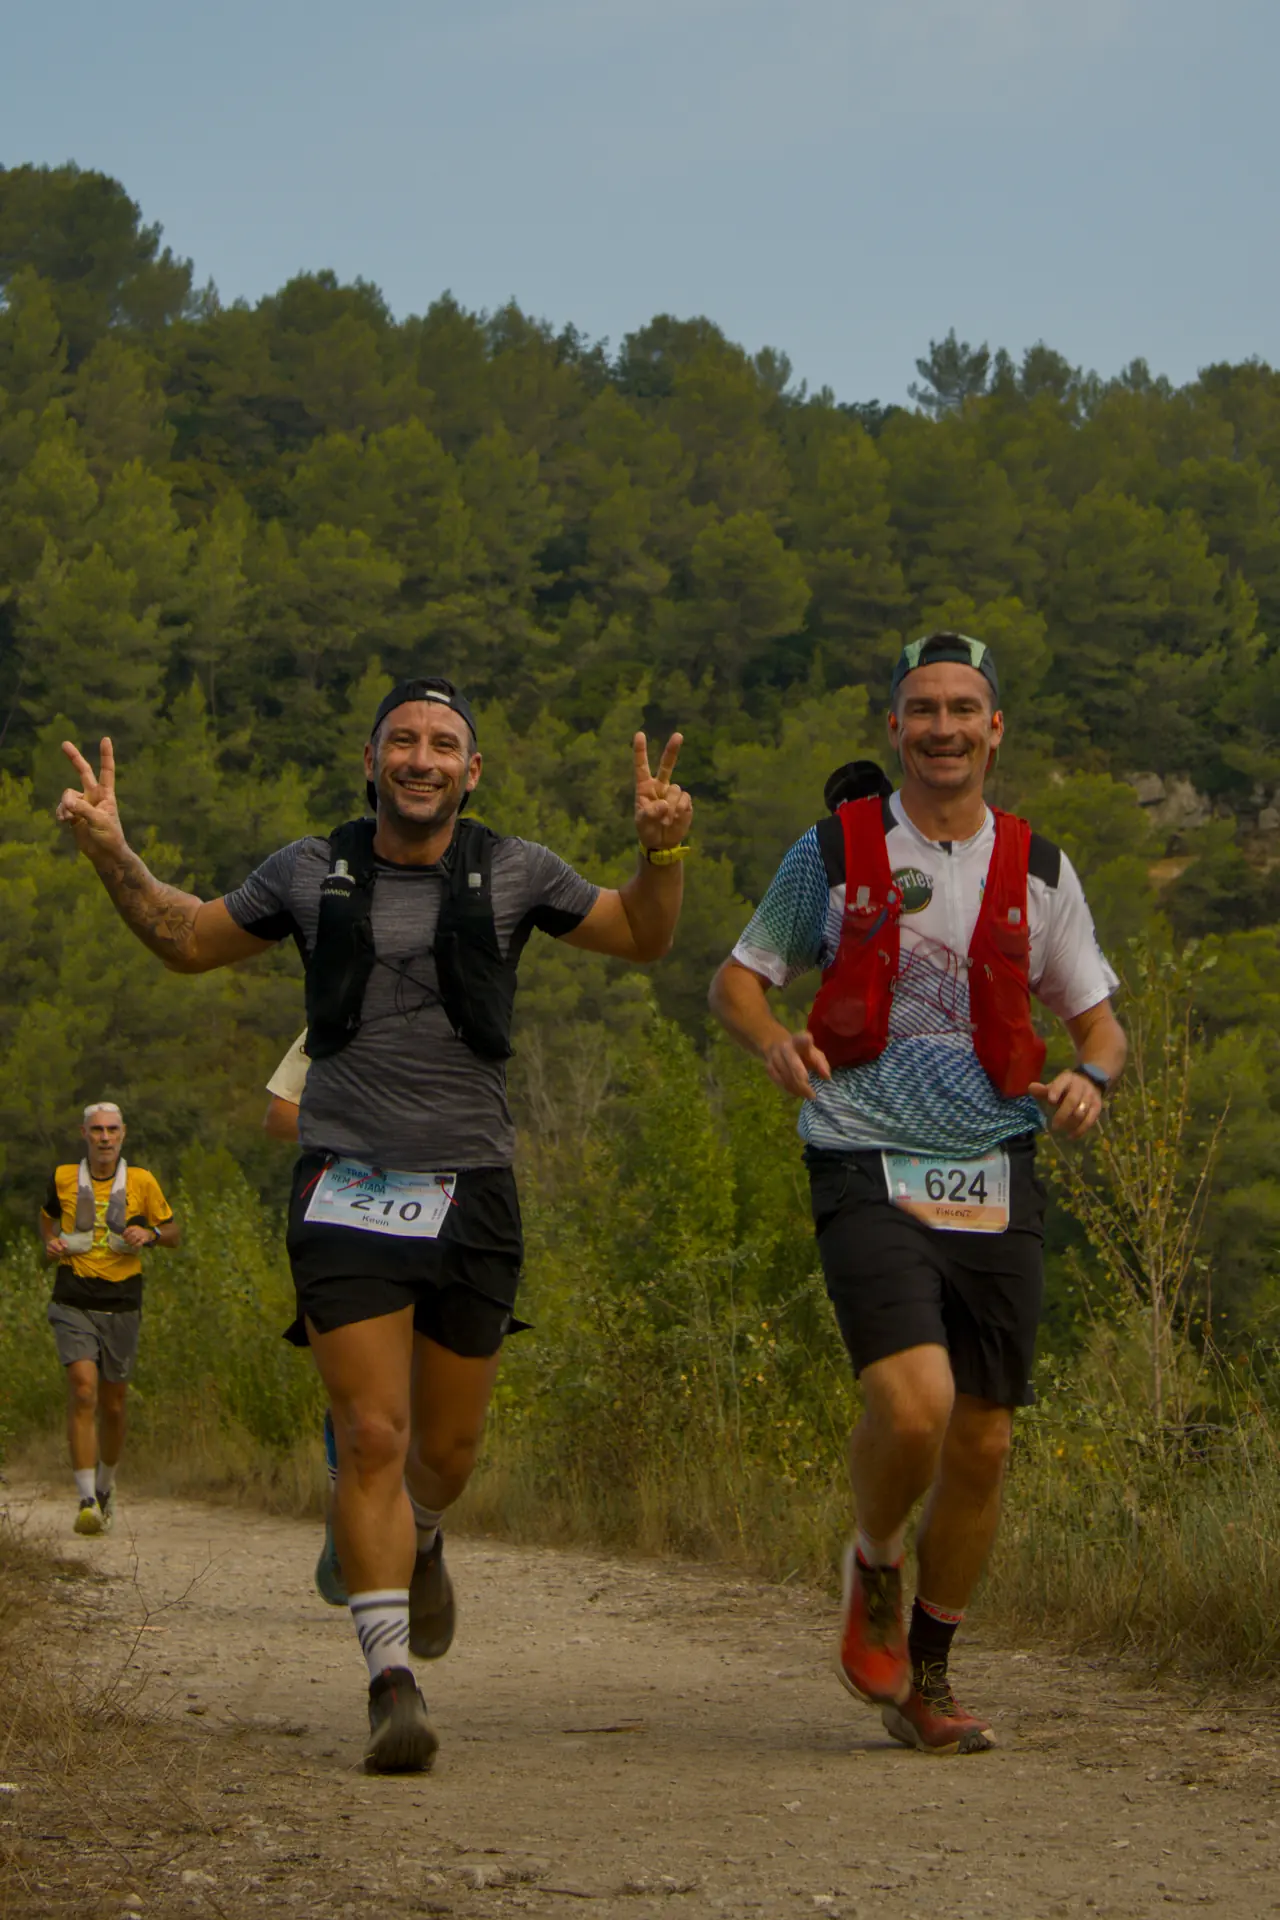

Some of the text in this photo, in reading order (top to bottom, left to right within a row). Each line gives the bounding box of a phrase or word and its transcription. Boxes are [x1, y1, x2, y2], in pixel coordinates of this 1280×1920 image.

[895, 868, 934, 890] rrier
[925, 1168, 988, 1205] 624
[350, 1193, 422, 1221] 210
[362, 1213, 389, 1227] Kevin
